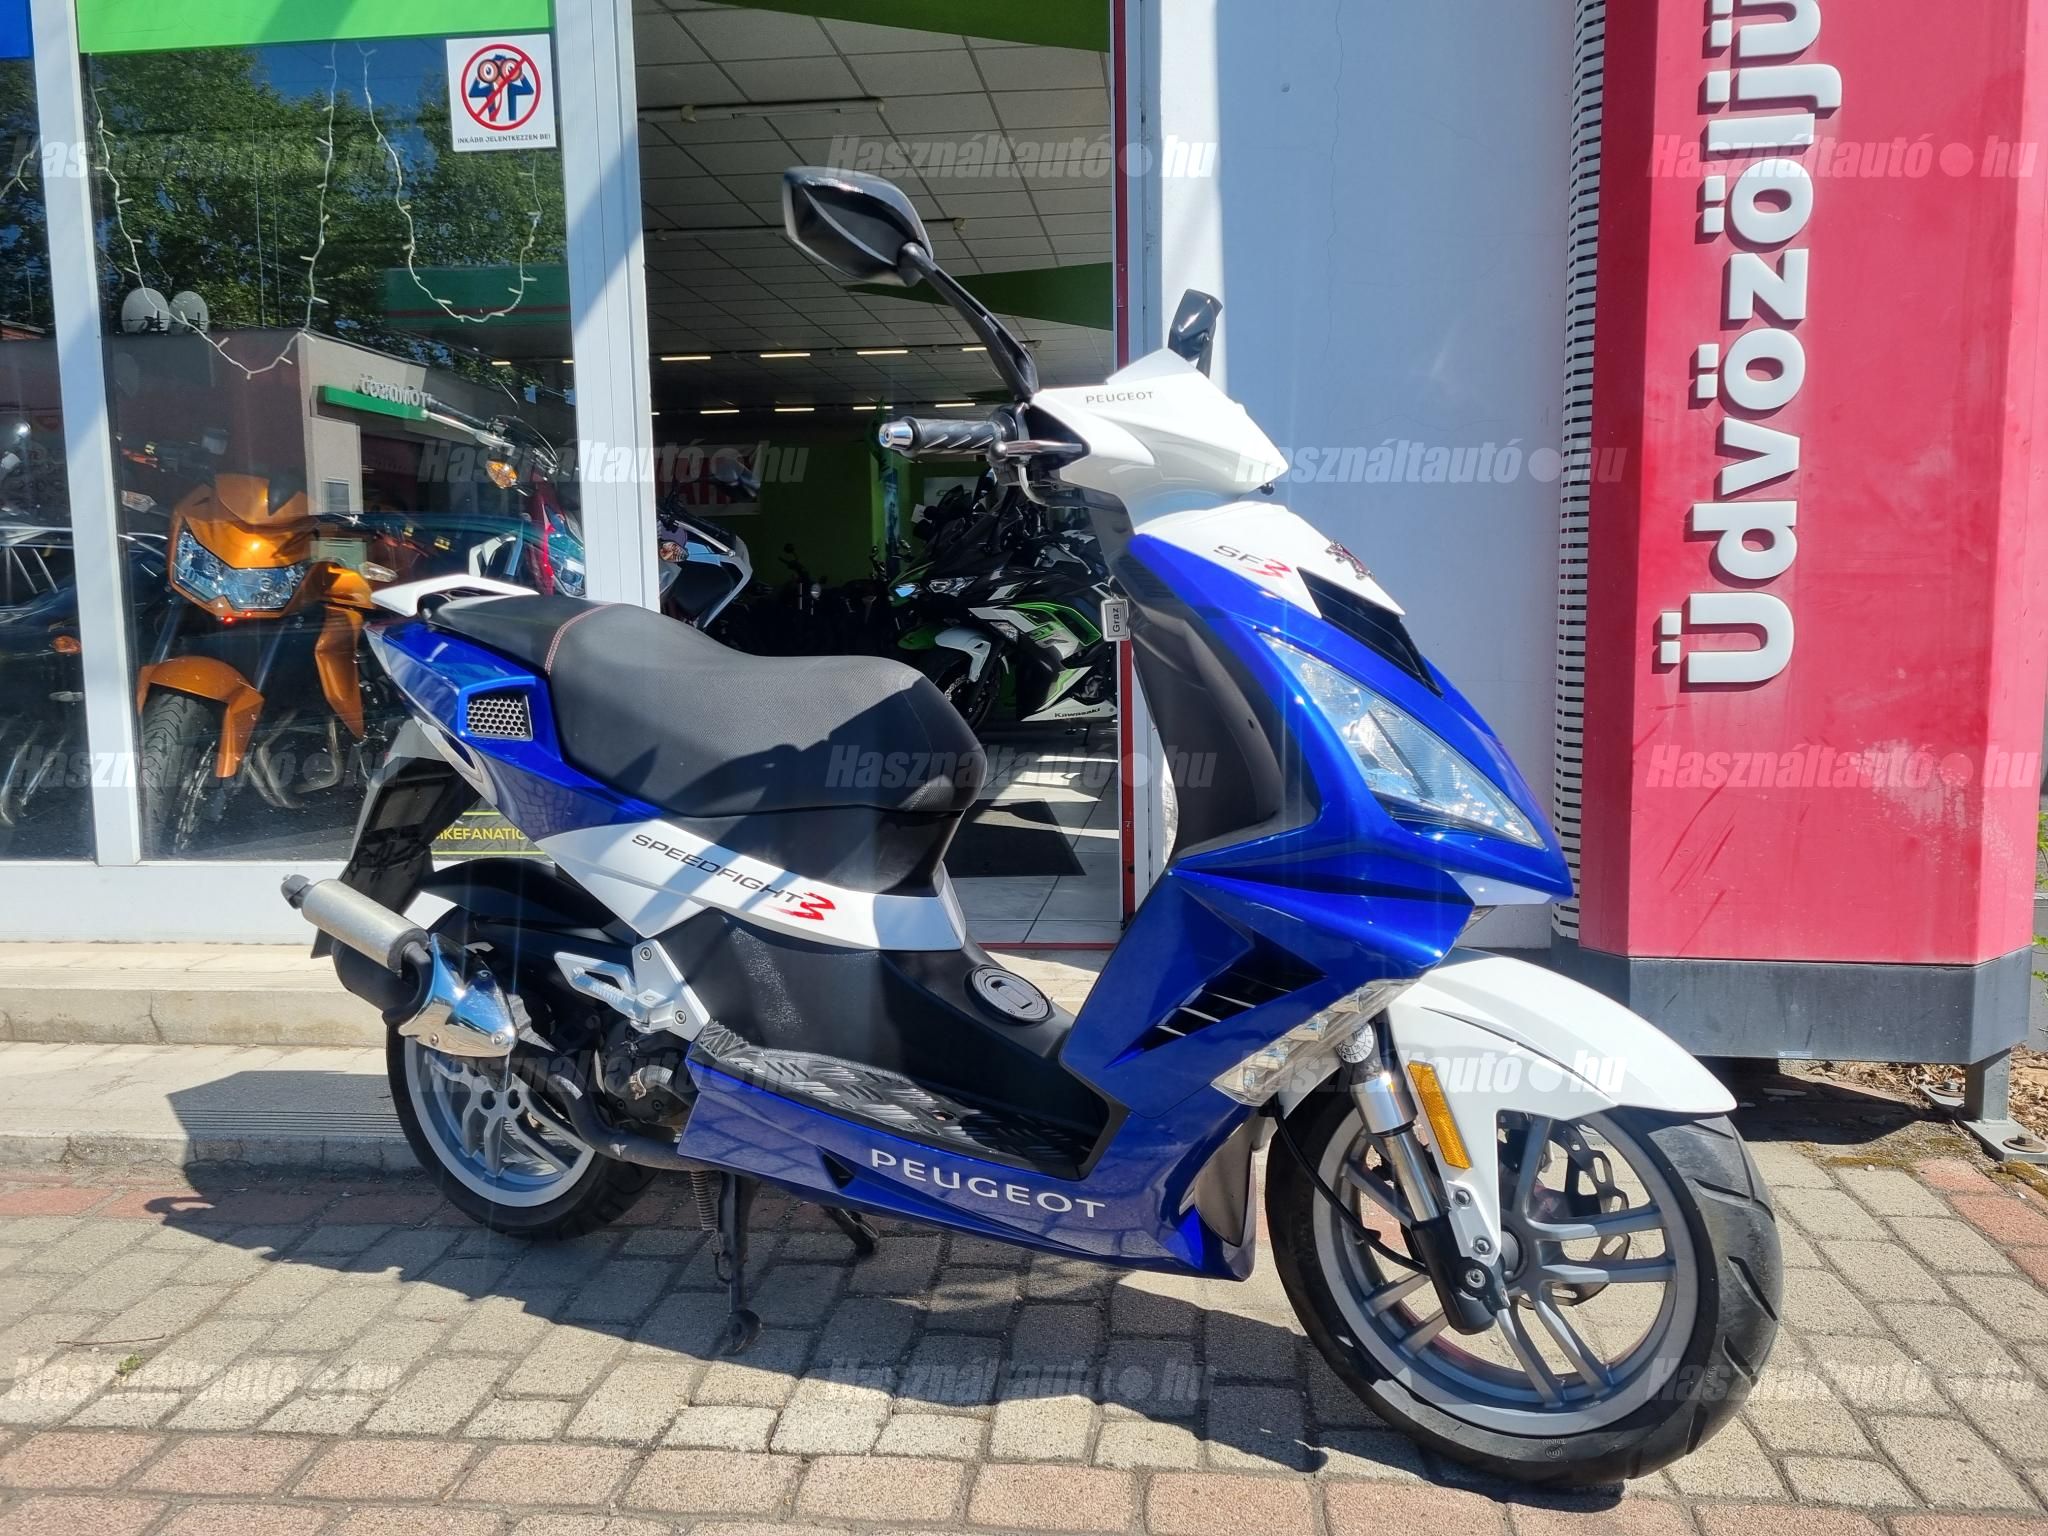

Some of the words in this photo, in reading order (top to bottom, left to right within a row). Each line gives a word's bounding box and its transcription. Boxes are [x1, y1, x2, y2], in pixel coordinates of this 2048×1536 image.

[1660, 0, 1842, 684] Üdvözöljü
[1085, 391, 1153, 404] PEUGEOT
[1112, 607, 1121, 632] Graz
[631, 834, 804, 903] SPEEDFIGHT
[871, 1148, 1106, 1218] PEUGEOT
